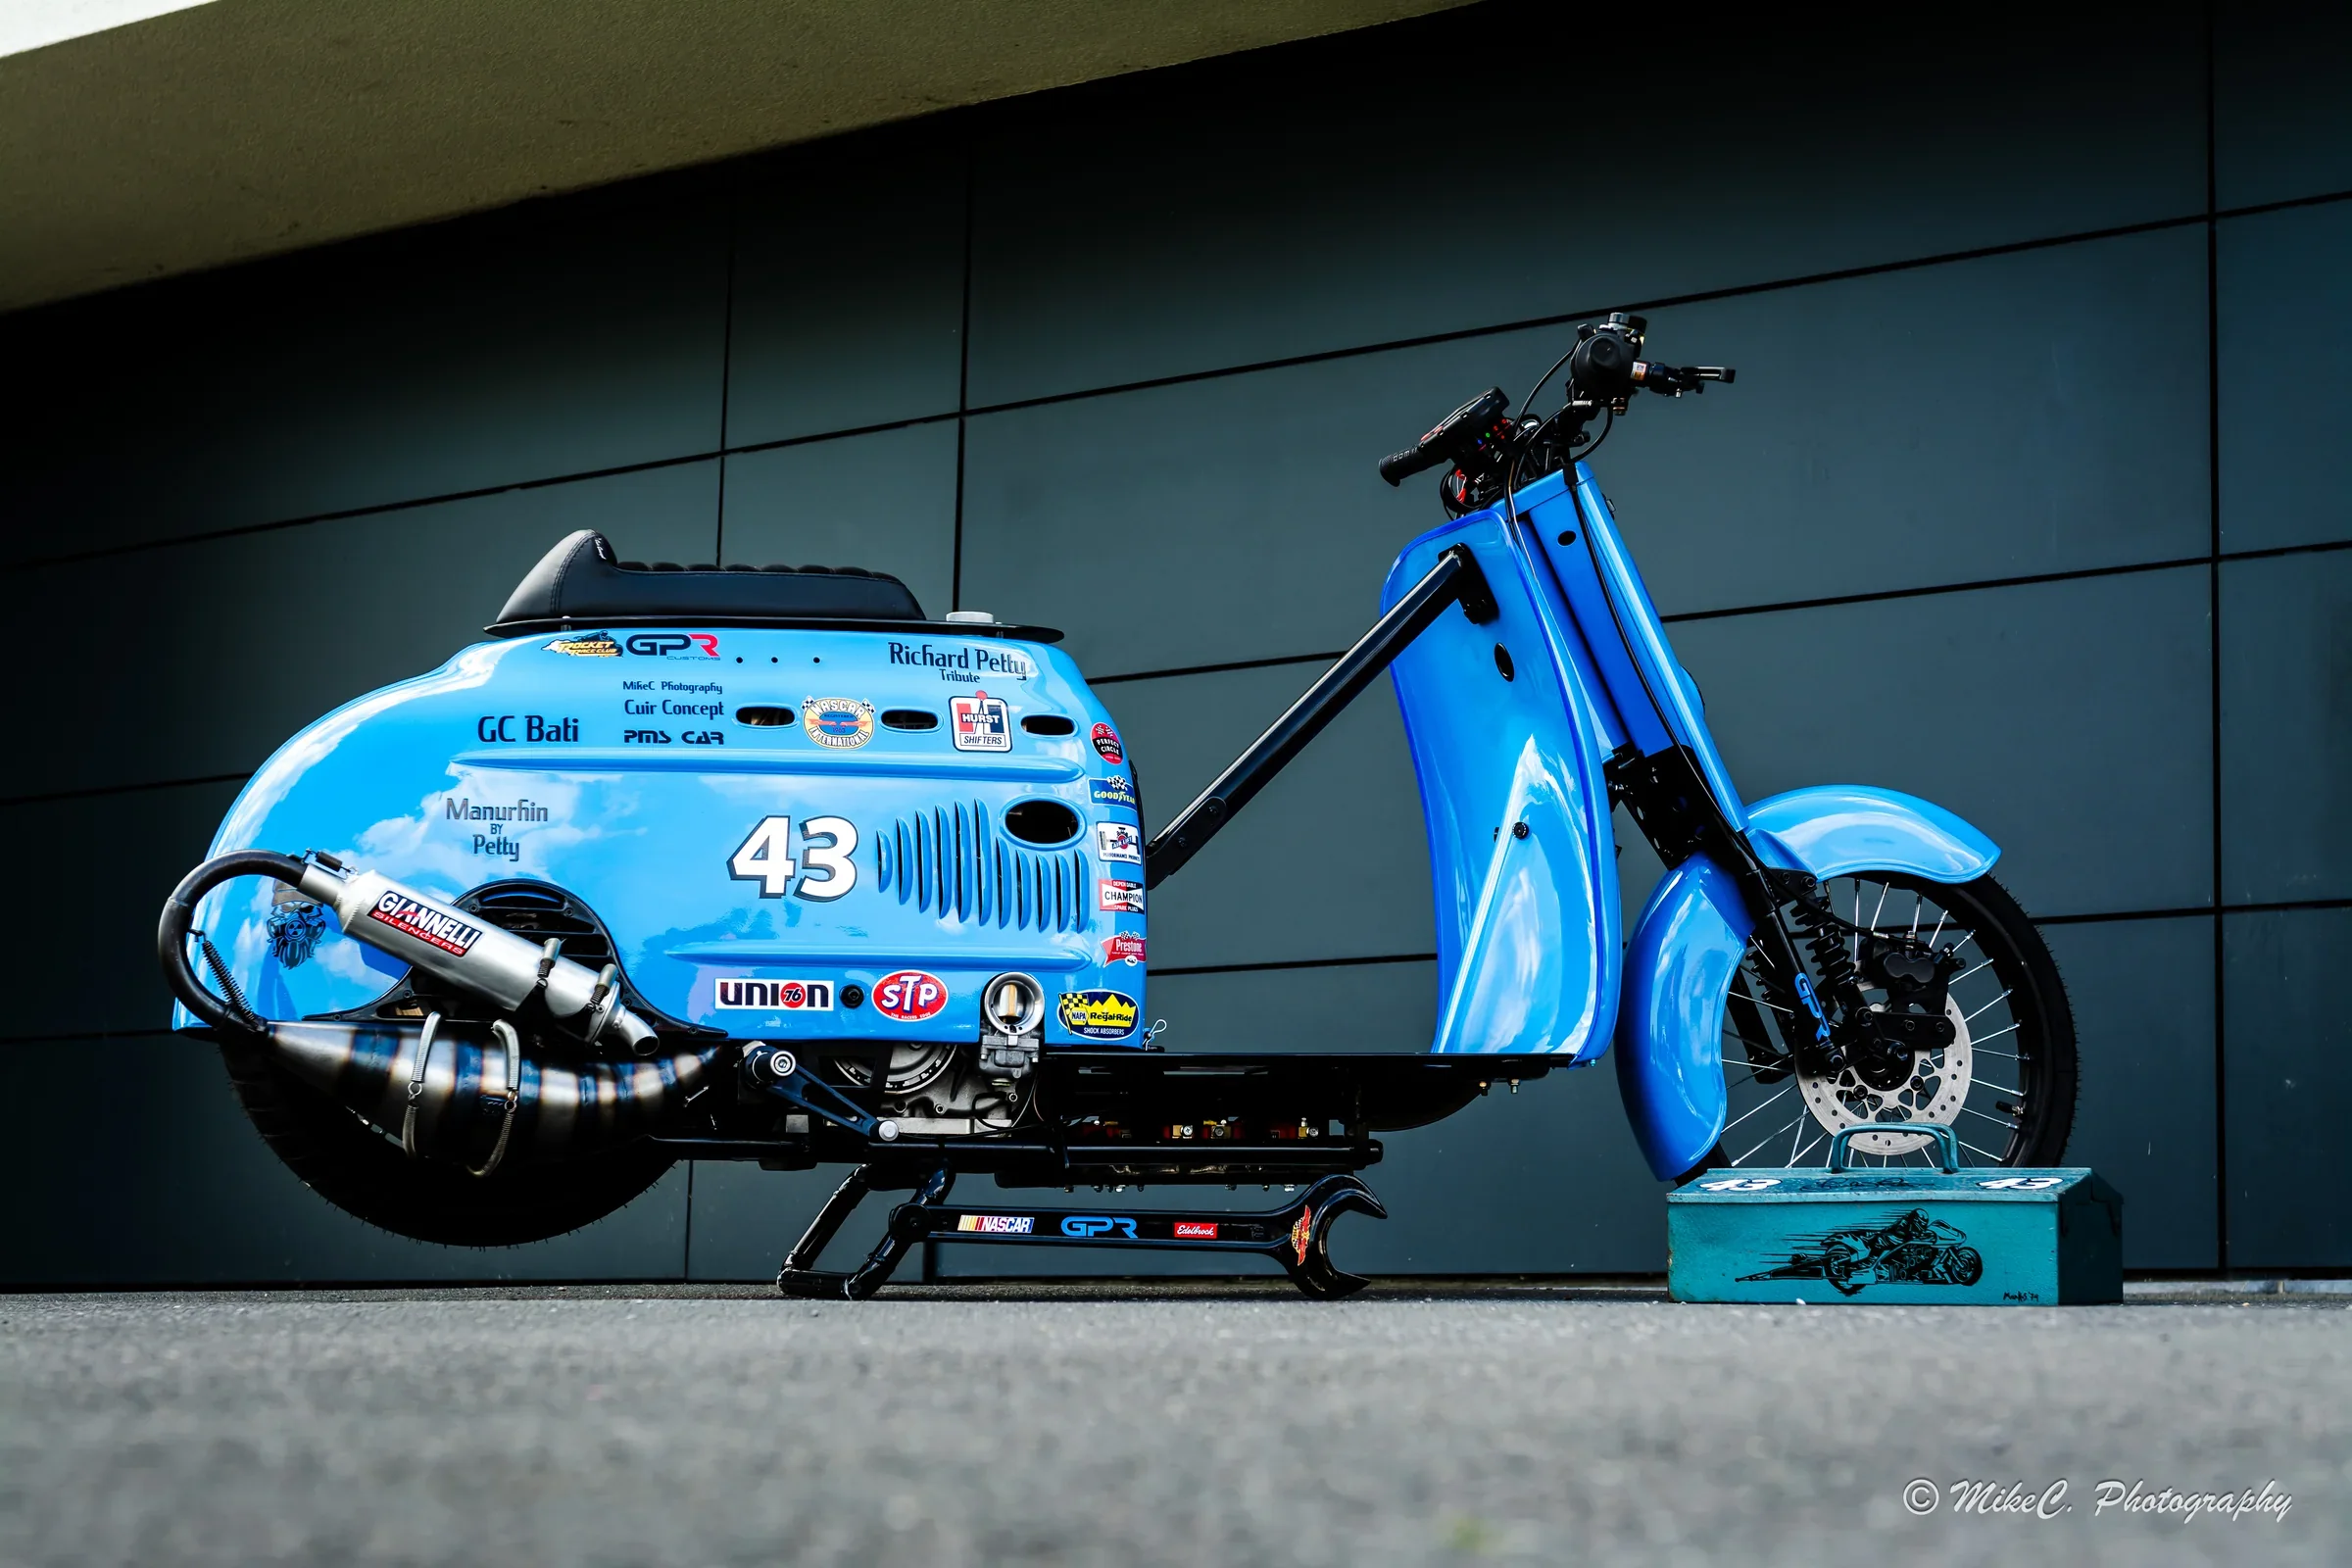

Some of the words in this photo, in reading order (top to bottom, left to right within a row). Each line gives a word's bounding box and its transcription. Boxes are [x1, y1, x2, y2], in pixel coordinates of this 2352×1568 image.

[558, 640, 614, 654] ROCKET
[626, 633, 720, 657] GPR
[888, 642, 969, 669] Richard
[975, 649, 1027, 681] Petty
[939, 668, 981, 683] Tribute
[622, 680, 656, 691] MikeC
[661, 681, 723, 695] Photography
[624, 699, 657, 715] Cuir
[662, 700, 724, 720] Concept
[809, 700, 866, 720] NASCAR
[960, 713, 1000, 724] HURST
[477, 715, 516, 743] GC
[525, 715, 579, 743] Bati
[623, 729, 672, 744] PMS
[681, 730, 725, 746] CAR
[808, 725, 870, 748] INTERNATIONAL
[963, 735, 1003, 745] SHIFTERS
[446, 798, 549, 822] Manurhin
[490, 824, 504, 835] BY
[473, 834, 520, 862] Petty
[725, 814, 860, 902] 43
[1104, 891, 1143, 904] CHAMPION
[377, 893, 480, 950] GIANNELLI
[372, 910, 464, 956] SILENCERS
[1115, 939, 1143, 953] Prestone
[719, 982, 829, 1008] UNION
[783, 988, 803, 1004] 76
[882, 975, 939, 1014] STP
[1071, 1011, 1087, 1020] NAPA
[1794, 972, 1832, 1042] GPR
[1083, 1026, 1100, 1035] SHOCK
[1100, 1027, 1125, 1036] ABSORBERS
[1699, 1177, 1783, 1192] 43
[1975, 1176, 2064, 1191] 43
[980, 1216, 1031, 1233] NASCAR
[1060, 1216, 1139, 1239] GPR
[1176, 1223, 1215, 1237] Edelbrock
